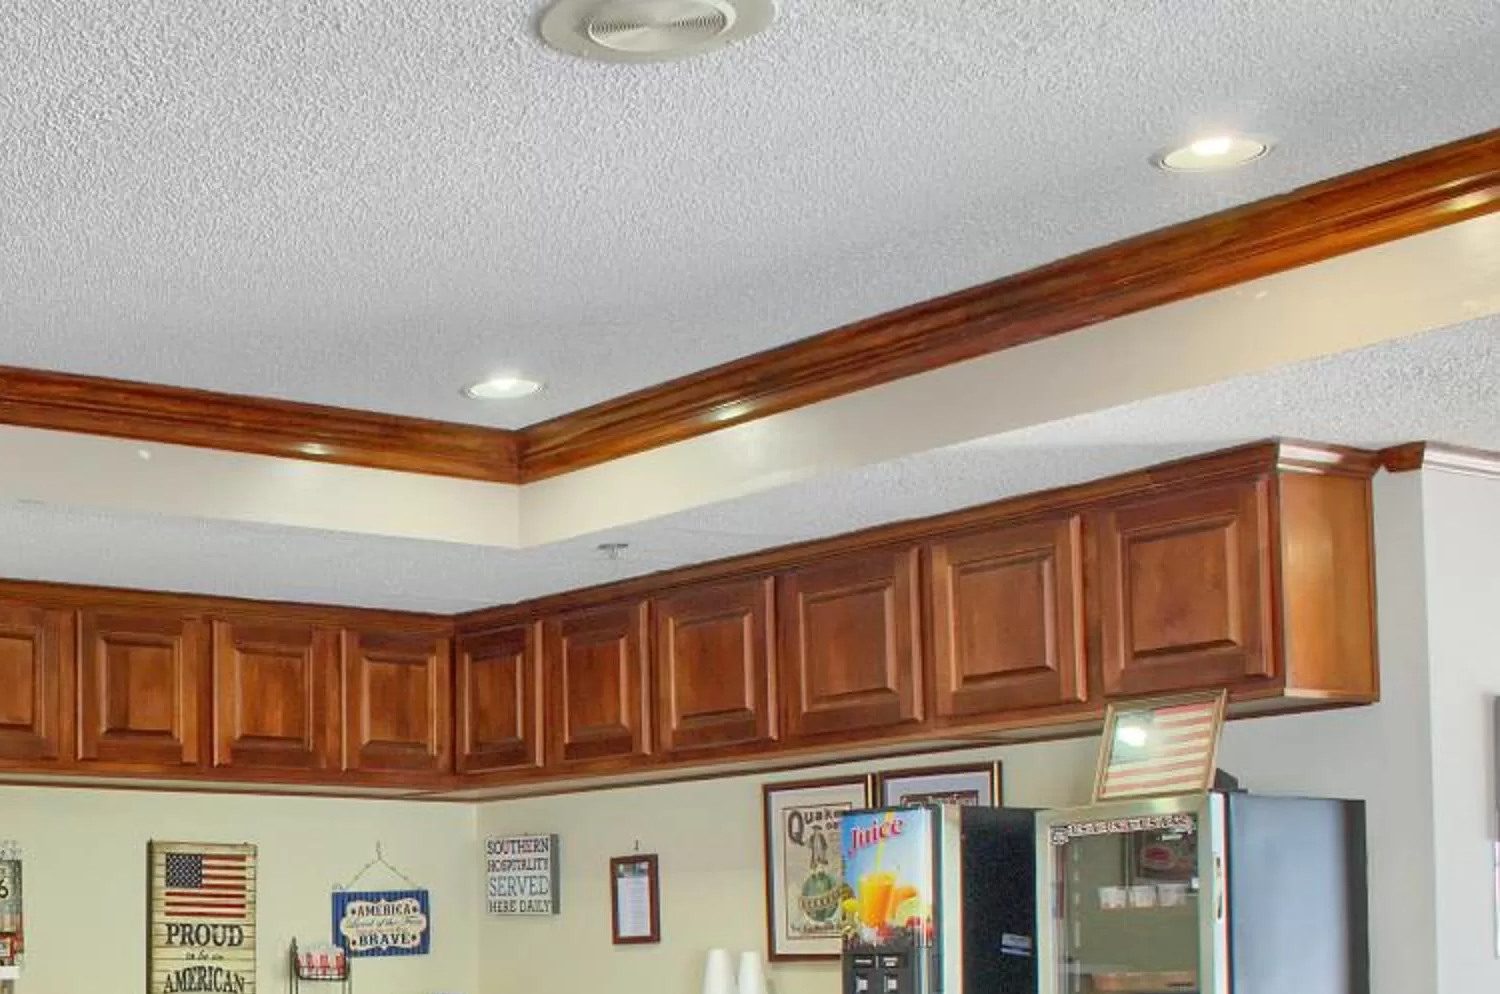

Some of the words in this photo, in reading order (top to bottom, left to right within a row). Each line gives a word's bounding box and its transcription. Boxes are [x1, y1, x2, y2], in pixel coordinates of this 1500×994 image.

[847, 817, 903, 858] Juice
[487, 838, 549, 855] SOUTHERN
[487, 858, 549, 872] HOSPITALITY
[489, 875, 549, 897] SERVED
[357, 903, 411, 917] AMERICA
[490, 901, 516, 912] HERE
[520, 900, 551, 912] DAILY
[165, 923, 244, 947] PROUD
[359, 933, 410, 945] BRAVE
[164, 965, 245, 994] AMERICAN
